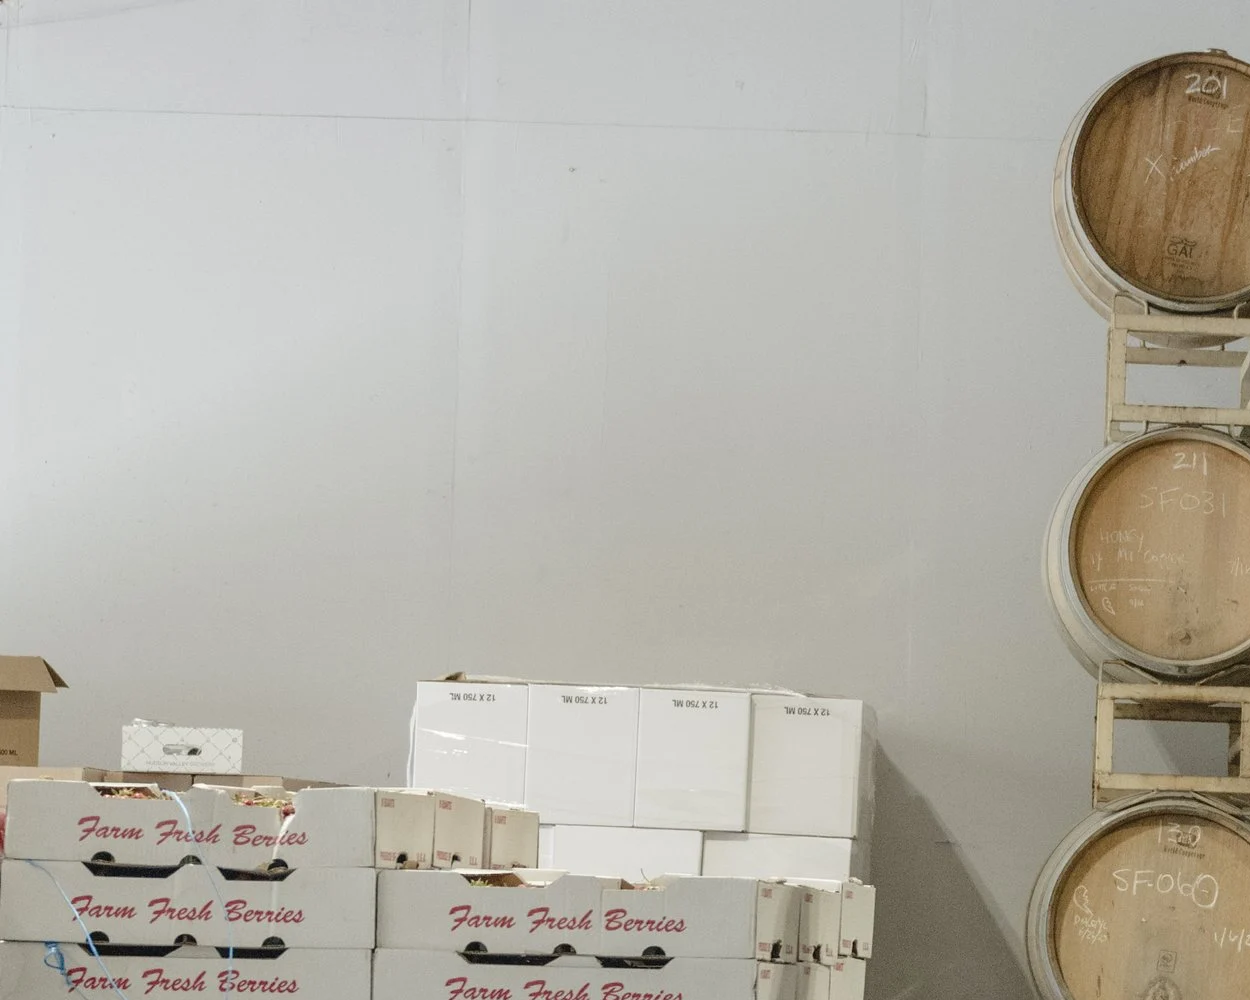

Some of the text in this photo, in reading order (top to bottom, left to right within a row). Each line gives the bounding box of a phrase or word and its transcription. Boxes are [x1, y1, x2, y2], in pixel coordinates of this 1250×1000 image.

[1184, 72, 1227, 99] 201
[1172, 451, 1208, 476] 211
[449, 692, 460, 701] ML
[463, 693, 476, 701] 750
[487, 693, 497, 702] 12
[562, 695, 608, 704] 12 X 750 ML
[672, 699, 719, 709] 12 X 750 ML
[784, 706, 795, 715] ML
[821, 708, 831, 716] 12
[78, 815, 144, 842] Farm
[155, 819, 222, 846] Fresh
[71, 895, 305, 925] Farm Fresh Berries
[447, 904, 687, 934] Farm Fresh Berries
[67, 966, 299, 995] Farm Fresh Berries
